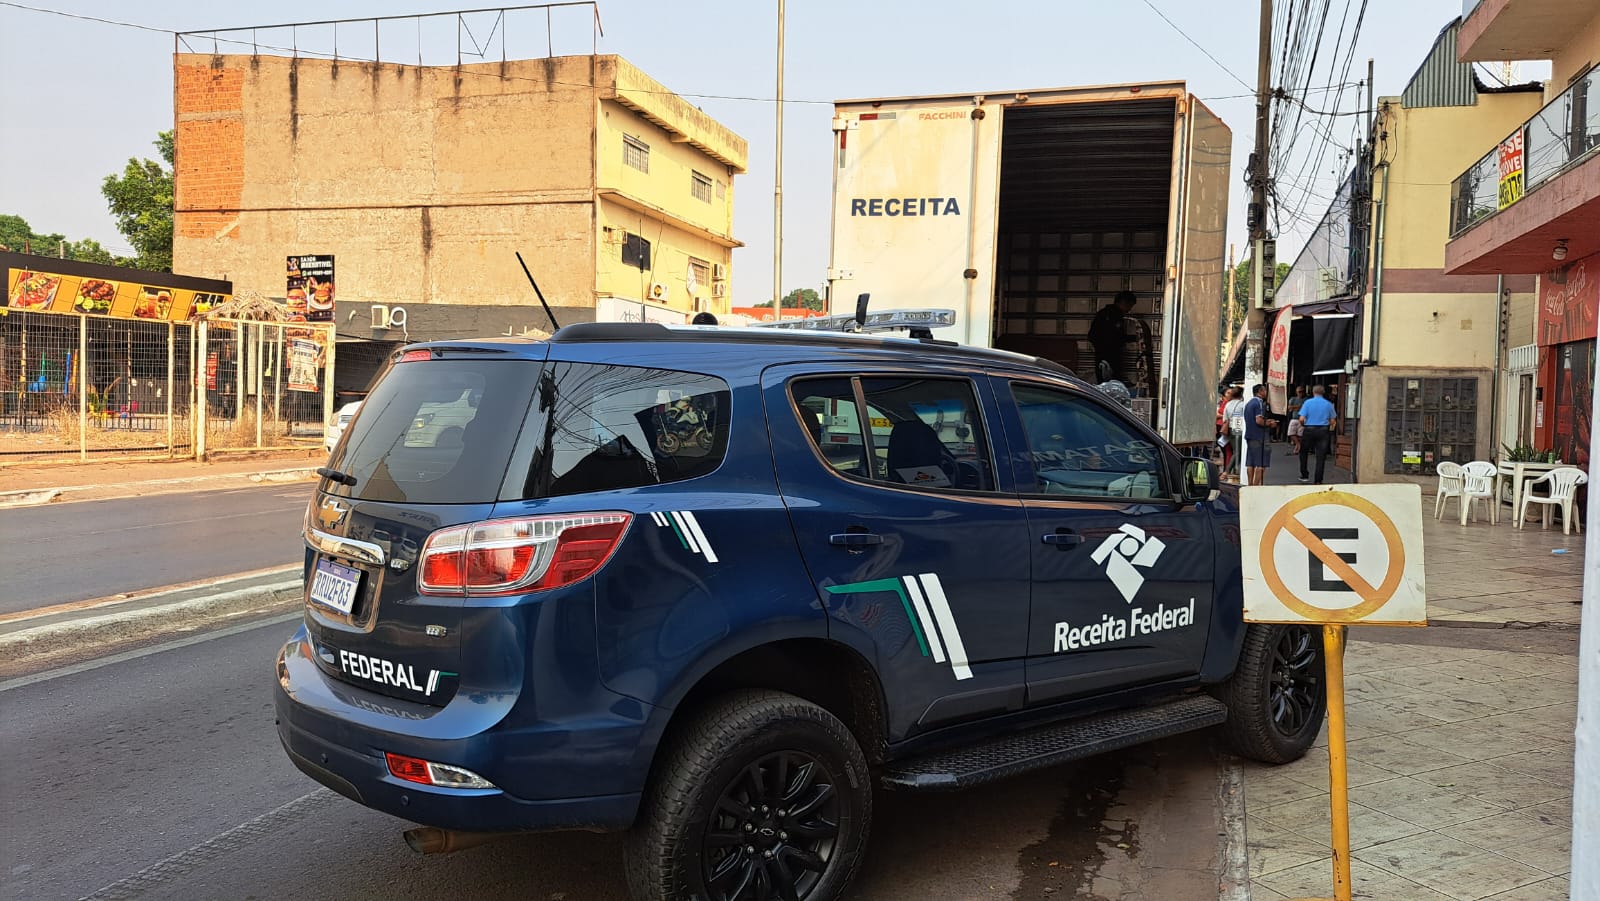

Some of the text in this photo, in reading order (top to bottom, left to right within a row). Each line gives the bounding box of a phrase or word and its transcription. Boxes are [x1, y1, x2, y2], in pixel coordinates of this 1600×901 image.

[918, 111, 966, 120] FACCHINI
[851, 198, 960, 216] RECEITA
[1308, 528, 1359, 591] E
[1054, 598, 1195, 653] Receita Federal
[340, 650, 424, 692] FEDERAL
